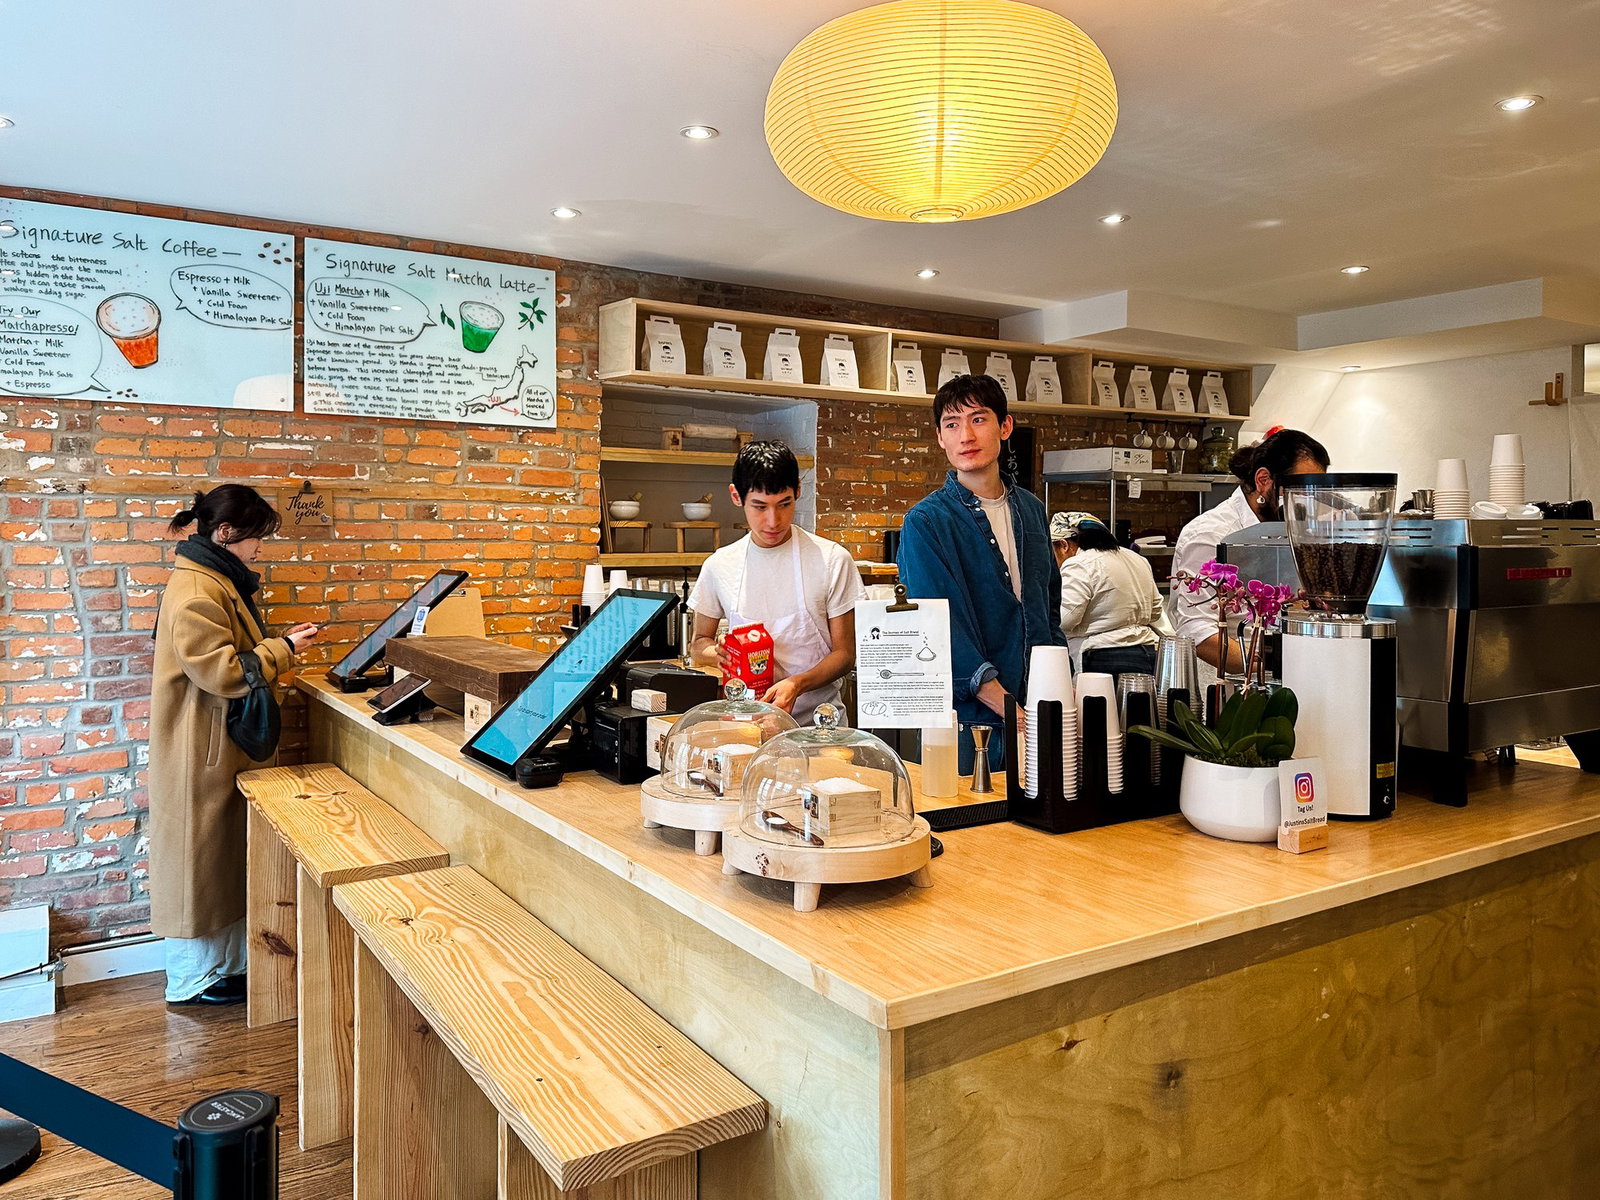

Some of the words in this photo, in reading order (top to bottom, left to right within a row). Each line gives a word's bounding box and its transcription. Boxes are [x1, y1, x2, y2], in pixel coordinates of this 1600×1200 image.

[0, 220, 104, 249] Signature
[112, 232, 149, 251] Salt
[161, 238, 218, 258] Coffee
[51, 254, 65, 262] the
[68, 255, 107, 265] bitterness
[20, 260, 34, 268] and
[37, 261, 60, 272] brings
[78, 265, 91, 273] the
[95, 268, 122, 276] natural
[25, 269, 50, 279] hidden
[326, 253, 396, 278] Signature
[407, 263, 436, 279] Salt
[446, 267, 492, 288] Matcha
[11, 277, 26, 287] why
[53, 281, 76, 289] taste
[178, 271, 221, 284] Espresso
[233, 276, 251, 285] Milk
[39, 288, 62, 299] adding
[200, 287, 231, 297] Vanilla
[237, 289, 281, 301] Sweetener
[315, 282, 330, 295] Uji
[335, 284, 365, 296] Matcha
[373, 290, 390, 298] Milk
[20, 306, 41, 316] Our
[206, 300, 225, 308] Cold
[228, 301, 248, 310] Foam
[318, 300, 347, 309] Vanilla
[350, 301, 389, 312] Sweetener
[213, 311, 258, 323] Himalayan
[260, 315, 276, 324] Pink
[327, 311, 344, 320] Cold
[347, 313, 366, 321] Foam
[0, 319, 79, 335] Matchapresso!
[335, 322, 376, 335] Himalayan
[379, 325, 395, 335] Pink
[399, 326, 415, 336] Salt
[45, 338, 64, 347] Milk
[0, 347, 29, 356] Vanilla
[0, 368, 34, 377] malayan
[38, 368, 54, 377] Pink
[14, 379, 51, 389] Espresso
[286, 490, 325, 511] Thank
[295, 509, 320, 525] you
[747, 648, 771, 658] HORIZON
[1306, 804, 1314, 812] Us!
[210, 1101, 245, 1120] LANCASTER
